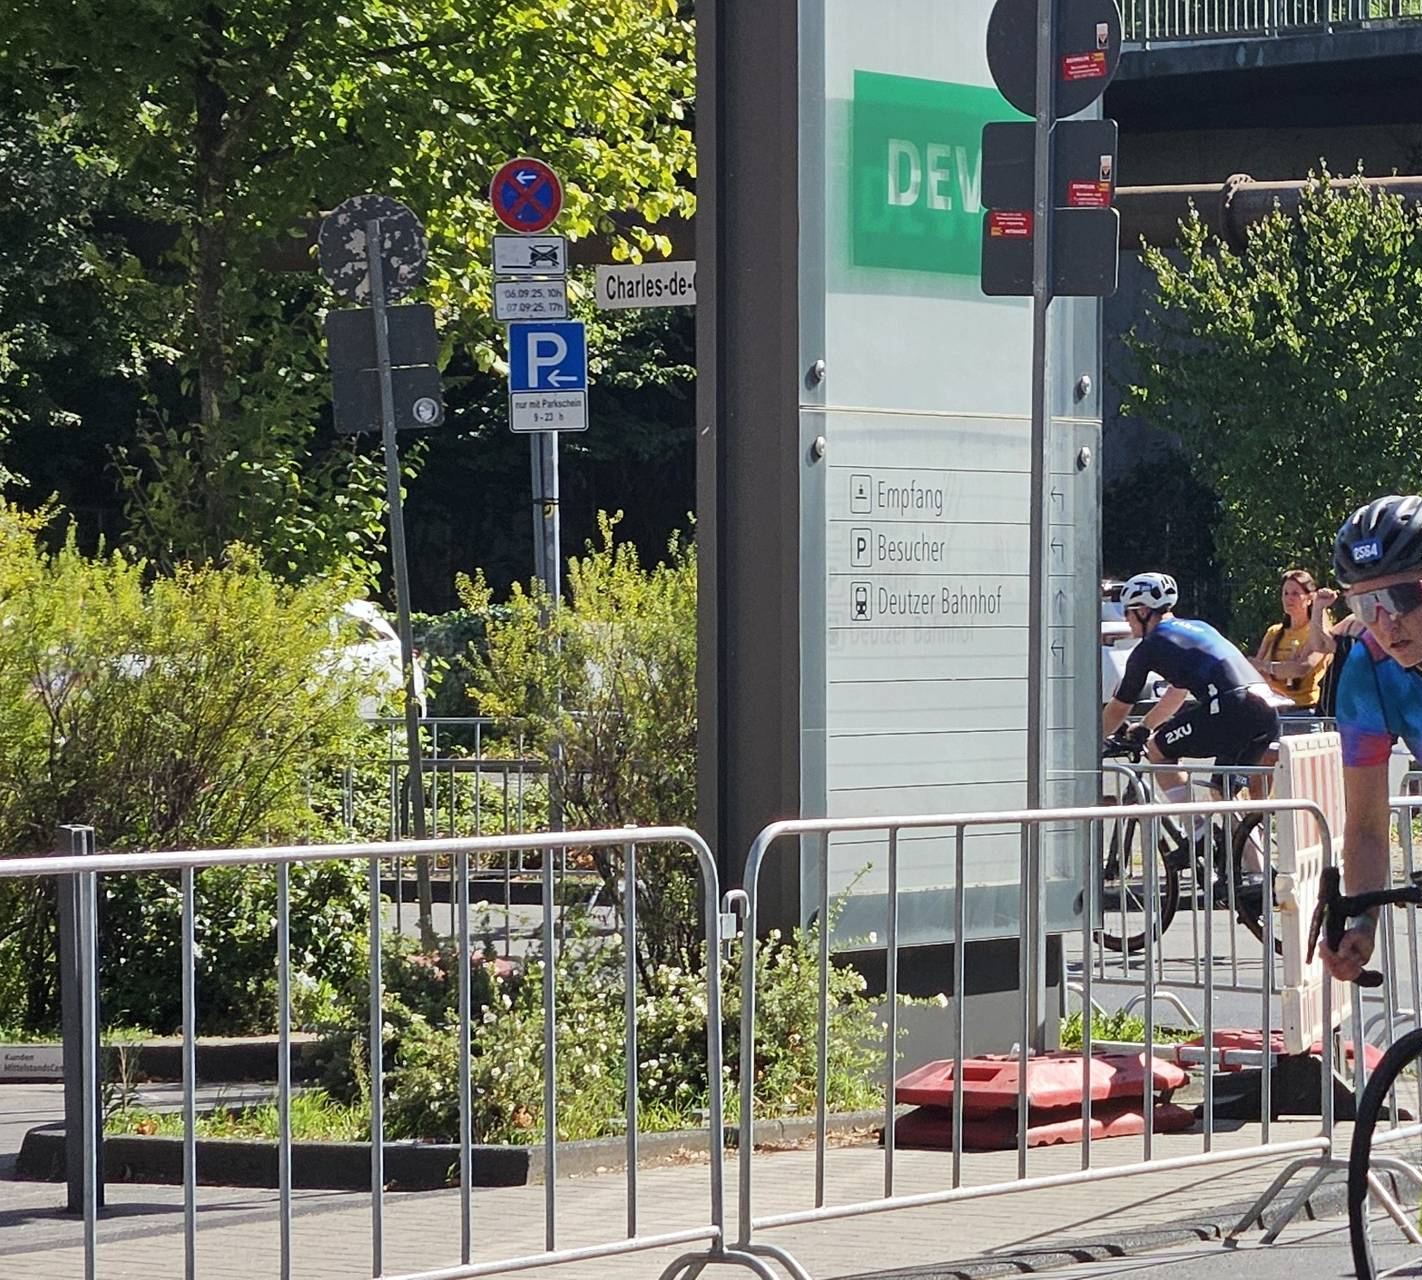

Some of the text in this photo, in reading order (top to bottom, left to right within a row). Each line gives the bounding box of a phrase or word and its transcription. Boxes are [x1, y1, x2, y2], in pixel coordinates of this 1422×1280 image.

[606, 271, 697, 300] Charles-de-
[527, 332, 568, 388] P
[515, 399, 581, 409] nur mit Parkschein
[878, 480, 944, 516] Empfang
[856, 533, 946, 562] P Besucher
[878, 585, 1002, 615] Deutzer Bahnhof
[1165, 723, 1192, 744] 2XU
